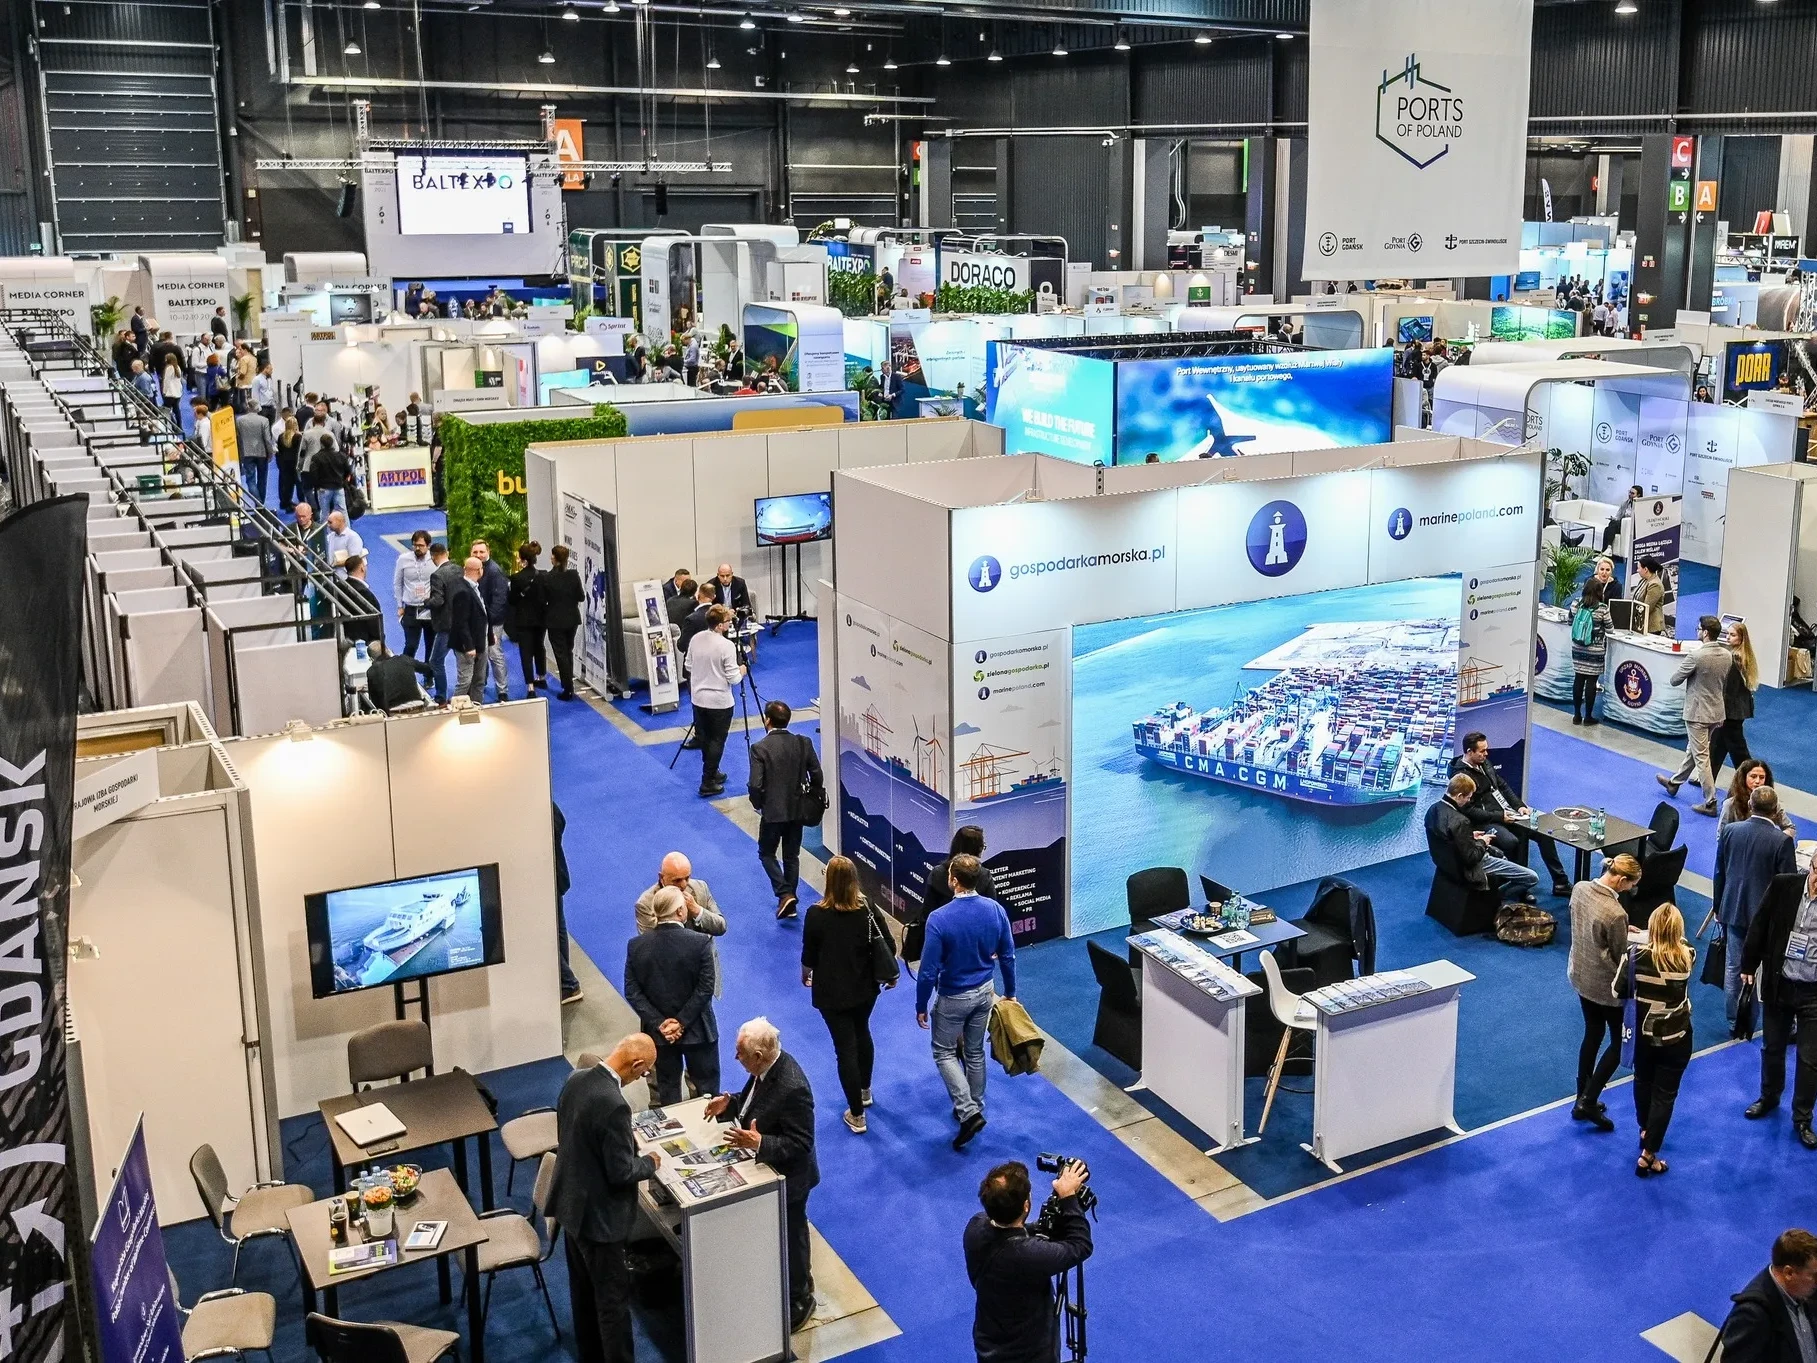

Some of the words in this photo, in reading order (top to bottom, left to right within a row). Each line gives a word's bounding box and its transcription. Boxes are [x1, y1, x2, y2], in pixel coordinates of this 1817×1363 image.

[1397, 97, 1463, 121] PORTS
[1397, 123, 1413, 137] OF
[1416, 124, 1462, 138] POLAND
[557, 129, 581, 162] A
[1677, 141, 1689, 162] C
[1674, 185, 1685, 206] B
[1699, 185, 1712, 206] A
[1341, 243, 1364, 251] GDAŃSK
[951, 261, 1016, 289] DORACO
[157, 282, 186, 290] MEDIA
[188, 281, 225, 290] CORNER
[9, 291, 40, 299] MEDIA
[44, 290, 85, 299] CORNER
[168, 299, 216, 307] BALTEXPO
[1176, 367, 1191, 376] Port
[1527, 414, 1543, 425] ORTS
[1649, 433, 1664, 442] PORT
[379, 468, 425, 483] ARTPOL
[1419, 504, 1524, 526] marinepoland.com
[1009, 545, 1166, 580] gospodarkamorska.pl
[1480, 574, 1521, 586] gospodarkamorska.pl
[989, 644, 1048, 659] gospodarkamorska.pl
[986, 661, 1050, 678] zielonagospodarka.pl
[992, 681, 1046, 694] marinepoland.com
[1184, 755, 1225, 777] CMA
[1239, 767, 1287, 790] CGM
[73, 794, 96, 811] RAJOWA
[96, 787, 108, 800] IZBA
[107, 773, 139, 794] GOSPODARKI
[93, 794, 119, 813] MORSKIEJ
[989, 866, 1009, 874] SLETTER
[992, 873, 1008, 882] NTENT
[1008, 867, 1037, 879] MARKETING
[902, 885, 925, 904] KONFERENCJ
[1002, 882, 1036, 895] KONFERENCJE
[1009, 891, 1033, 901] REKLAMA
[1017, 898, 1036, 907] SOCIAL
[1035, 895, 1052, 903] MEDIA
